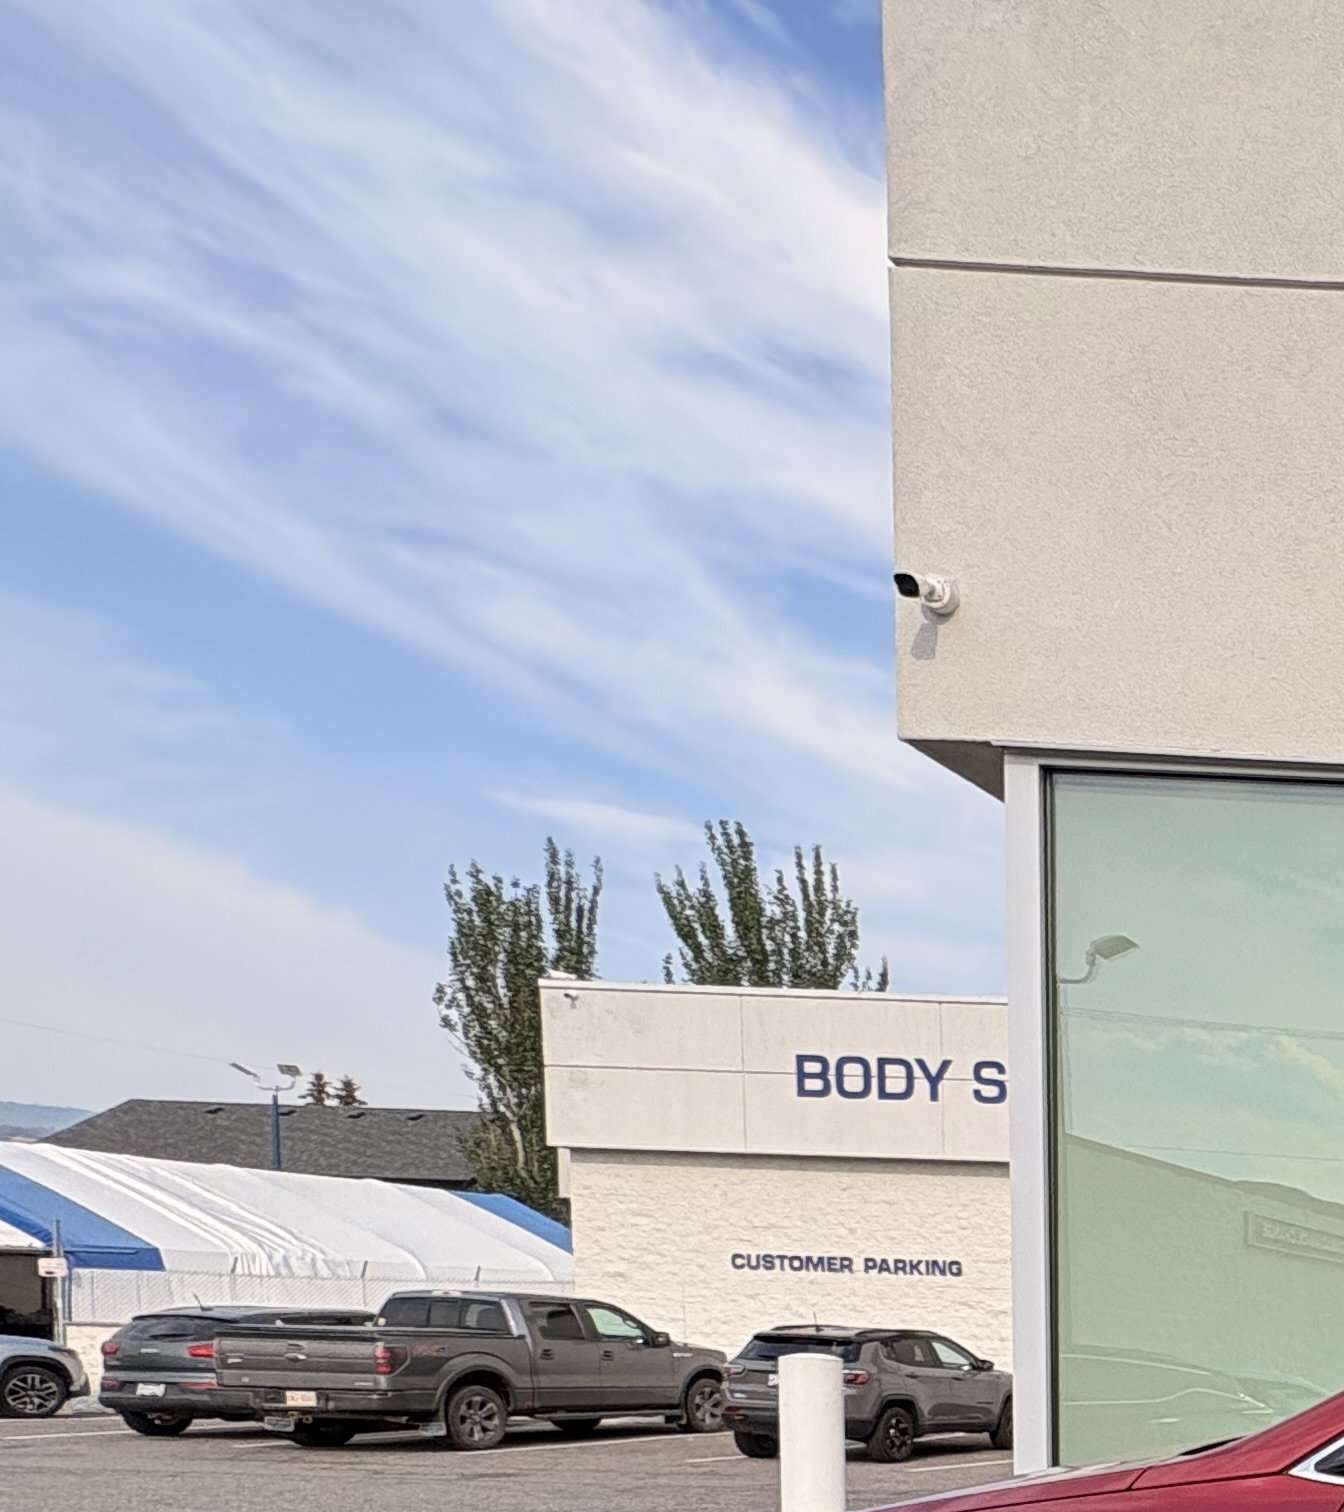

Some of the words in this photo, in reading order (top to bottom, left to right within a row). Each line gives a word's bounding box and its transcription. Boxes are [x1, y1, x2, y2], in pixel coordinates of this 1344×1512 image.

[796, 1054, 953, 1102] BODY
[731, 1253, 854, 1273] CUSTOMER
[863, 1257, 963, 1277] PARKING
